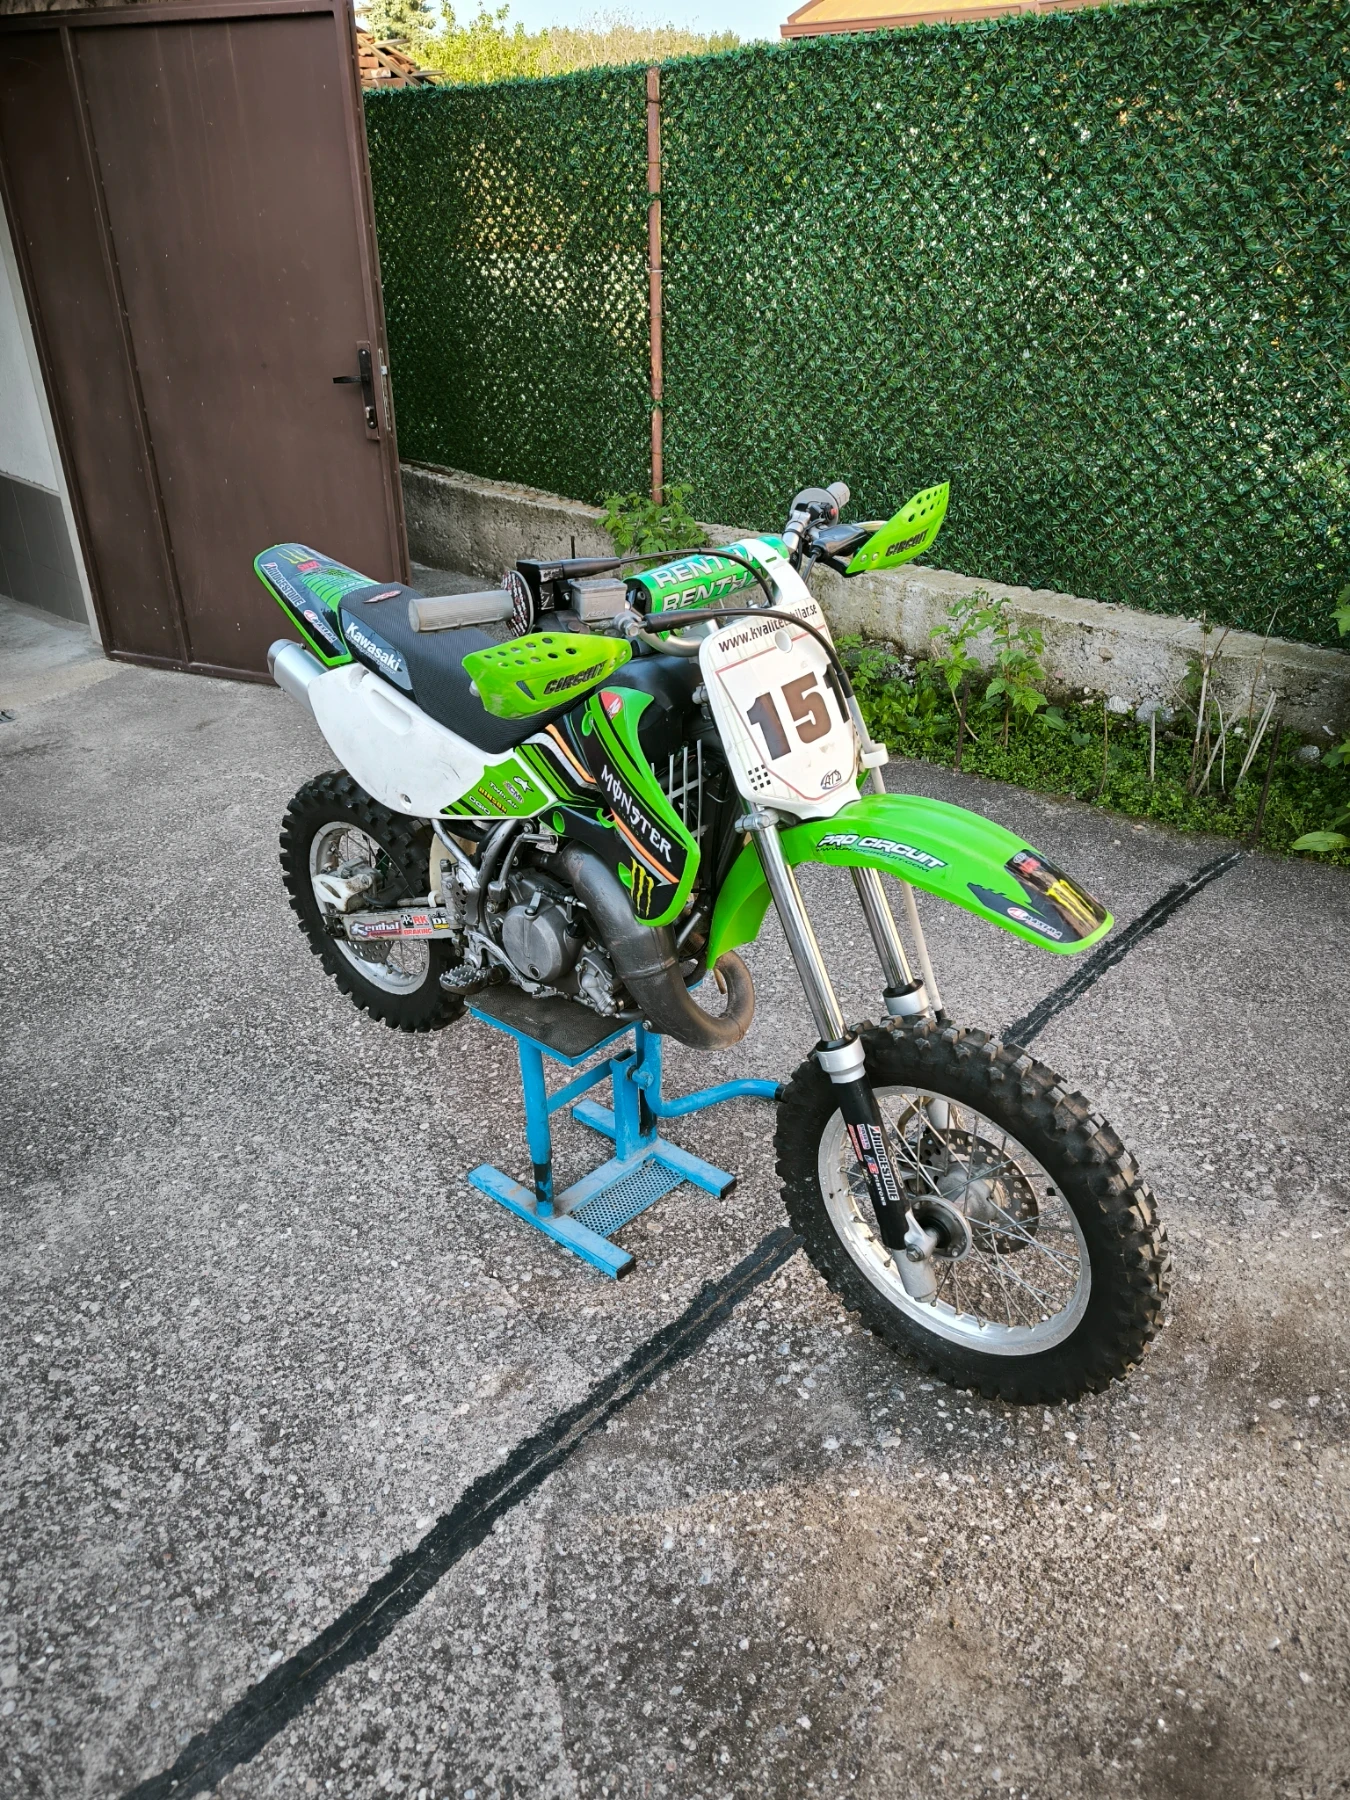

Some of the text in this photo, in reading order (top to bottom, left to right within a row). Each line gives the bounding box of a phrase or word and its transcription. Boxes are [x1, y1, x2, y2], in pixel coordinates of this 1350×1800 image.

[886, 528, 929, 557] CIRCUIT
[261, 562, 306, 607] BRIDGESTONE
[345, 621, 402, 671] Kawasaki
[543, 660, 608, 695] CIRCUIT
[746, 662, 850, 760] 151
[816, 833, 948, 869] PRO CIRCUIT
[350, 921, 400, 937] Renthal
[403, 928, 433, 937] BRAKING
[413, 915, 428, 926] RK
[867, 1124, 900, 1201] BRIDGESTONE
